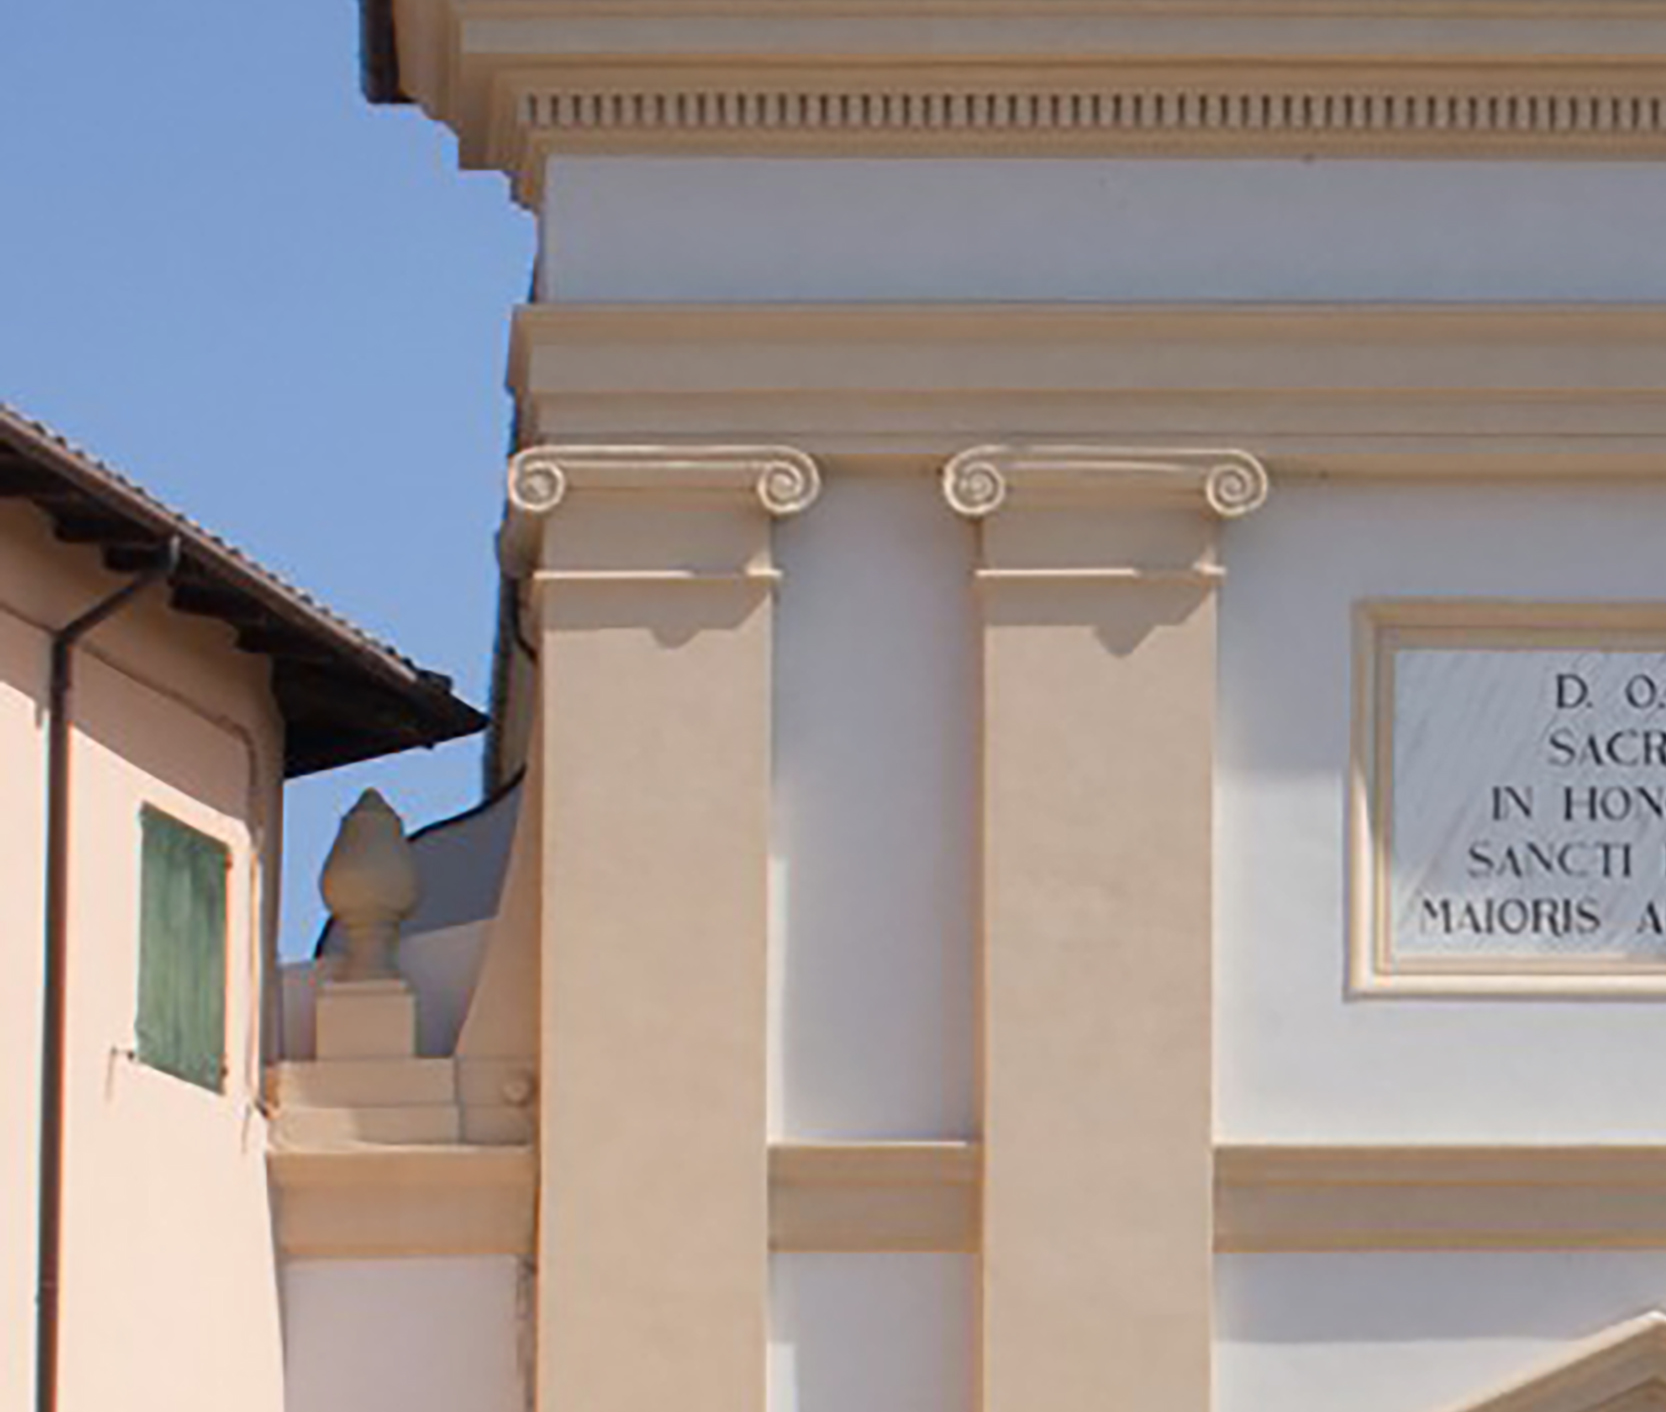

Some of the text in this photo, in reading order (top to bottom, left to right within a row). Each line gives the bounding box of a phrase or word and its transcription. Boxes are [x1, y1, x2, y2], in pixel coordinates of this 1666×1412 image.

[1555, 673, 1594, 710] D.
[1624, 673, 1666, 710] O.
[1492, 786, 1533, 821] IN
[1467, 842, 1633, 879] SANCTI
[1420, 897, 1602, 938] MAIORIS
